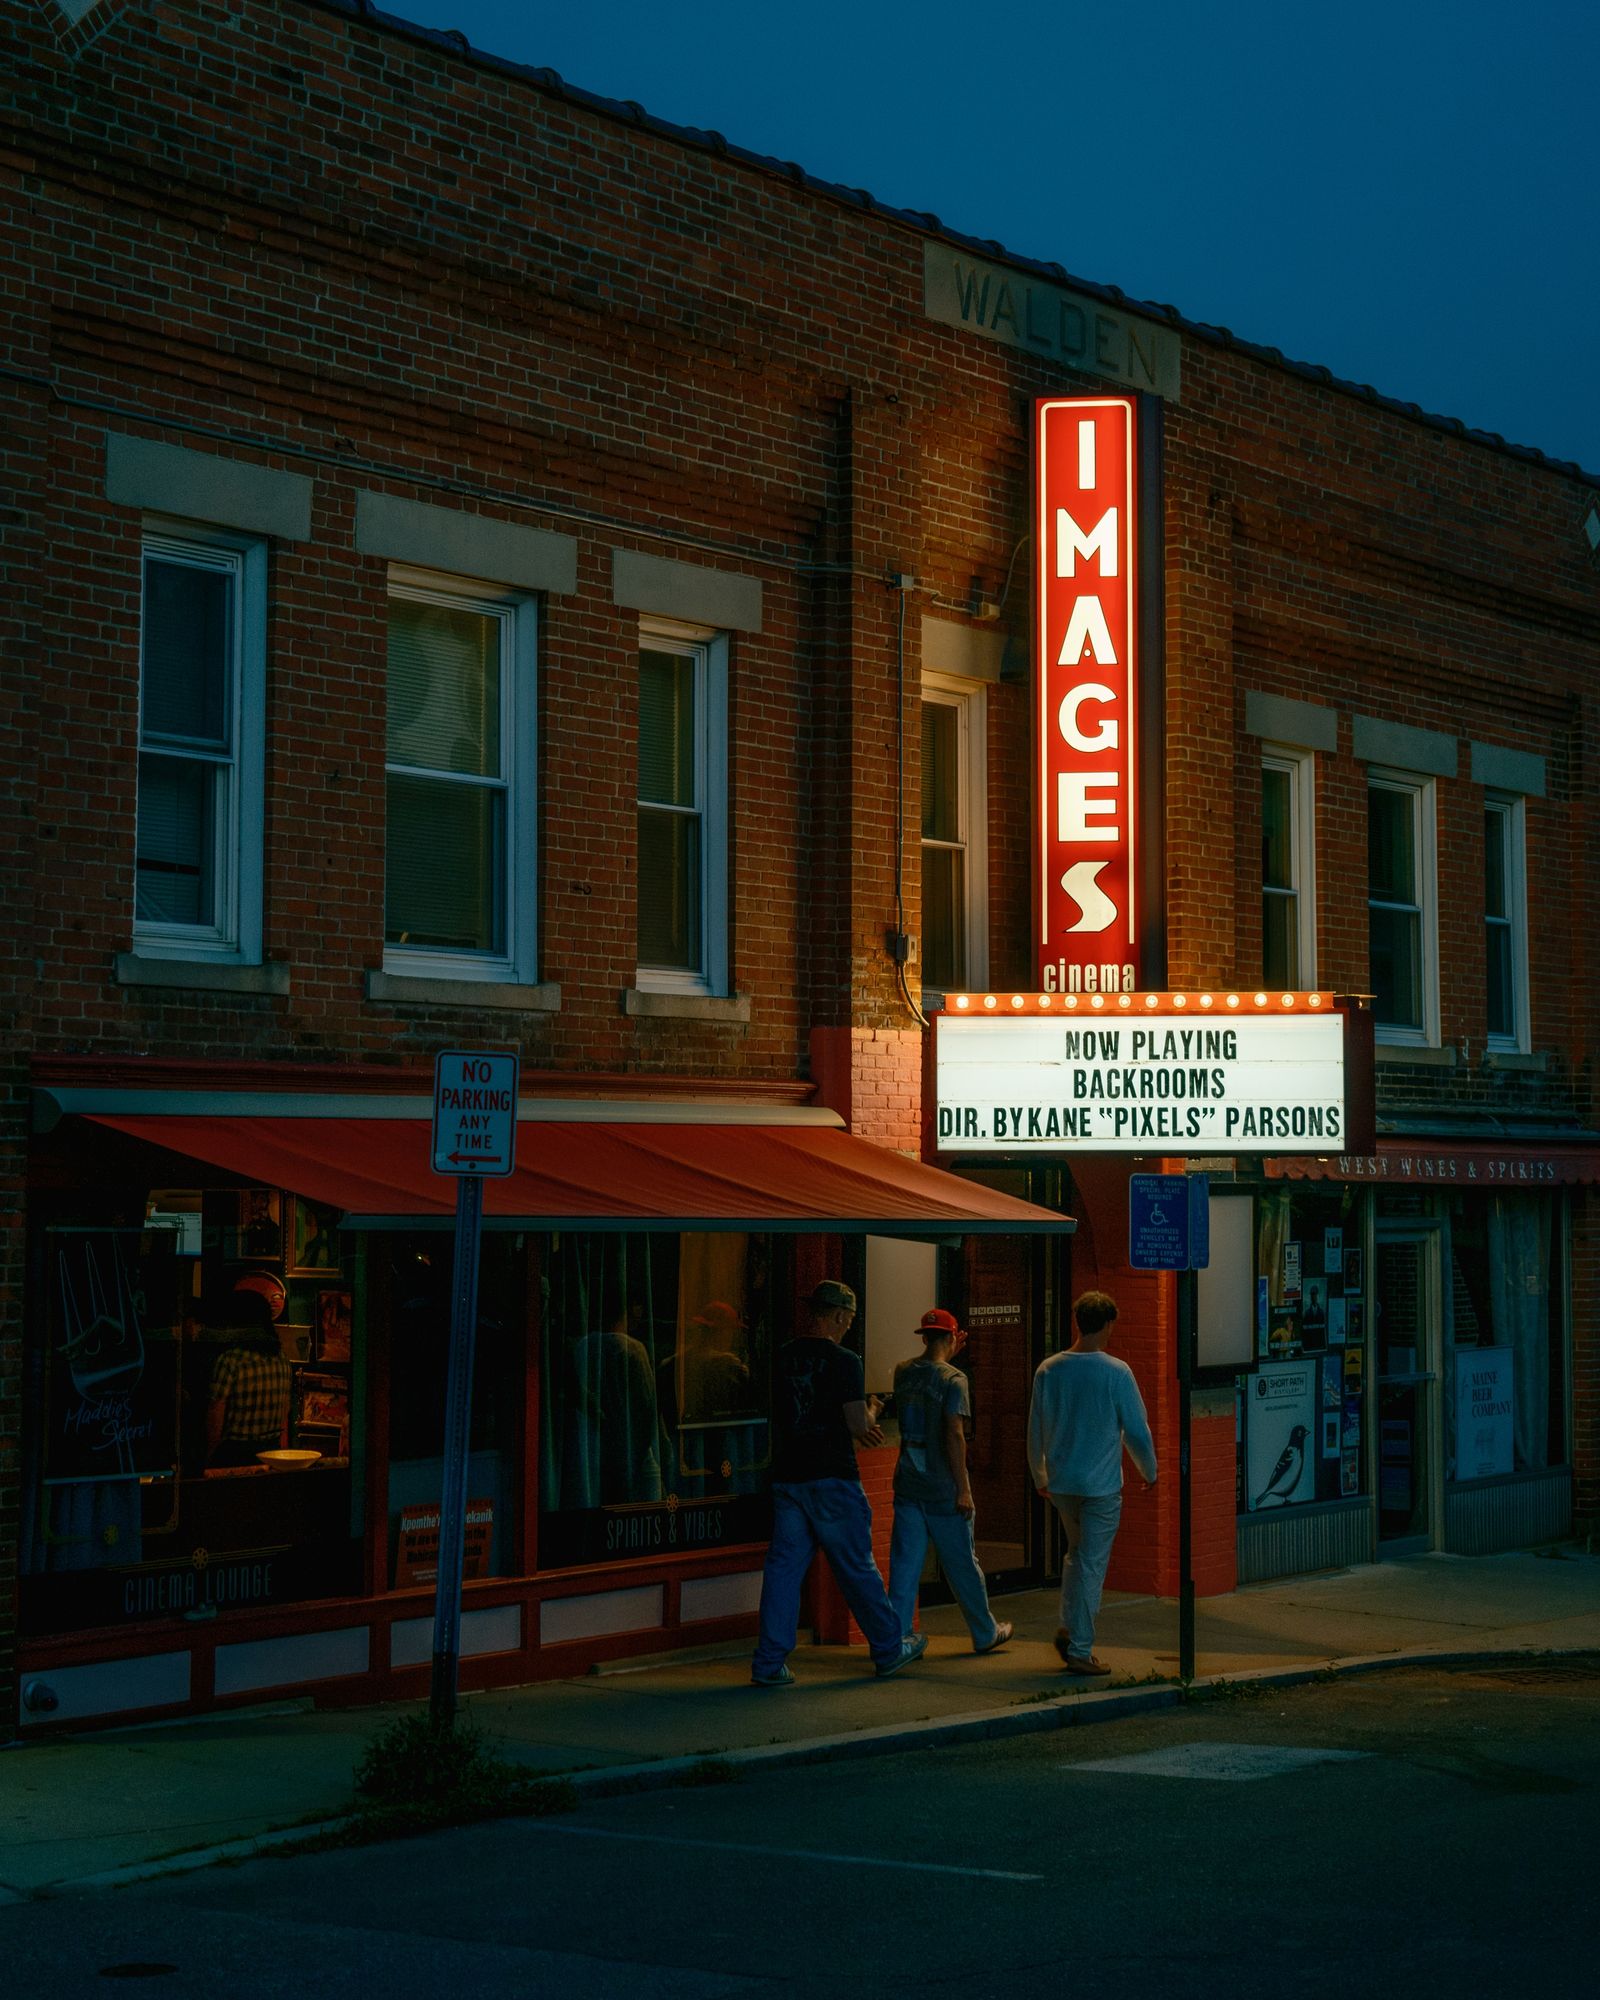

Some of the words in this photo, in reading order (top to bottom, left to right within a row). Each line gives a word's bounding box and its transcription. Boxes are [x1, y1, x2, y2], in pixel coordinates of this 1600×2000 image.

[953, 261, 1157, 385] WALDEN
[1056, 420, 1119, 933] IMAGES
[1043, 958, 1136, 993] cinema
[1065, 1030, 1120, 1061] NOW
[1132, 1029, 1237, 1060] PLAYING
[463, 1061, 491, 1083] NO
[1073, 1068, 1226, 1099] BACKROOMS
[441, 1087, 510, 1112] PARKING
[460, 1114, 491, 1131] ANY
[939, 1107, 987, 1138] DIR.
[1225, 1106, 1341, 1138] PARSONS
[454, 1133, 493, 1151] TIME
[1338, 1156, 1388, 1175] WEST
[1400, 1157, 1457, 1178] WINES
[1467, 1160, 1477, 1179] &
[1488, 1160, 1556, 1180] SPIRITS
[1134, 1179, 1162, 1187] HANDICA
[970, 1316, 1020, 1326] CINEMA
[1269, 1377, 1289, 1389] SHORT
[1289, 1376, 1304, 1387] PATH
[1471, 1387, 1493, 1402] BEER
[1471, 1399, 1513, 1419] COMPANY
[607, 1513, 661, 1550] SPIRITS
[668, 1512, 678, 1543] &
[683, 1508, 721, 1542] VIBES
[124, 1570, 197, 1616] CINEMA
[205, 1563, 273, 1604] LOUNGE
